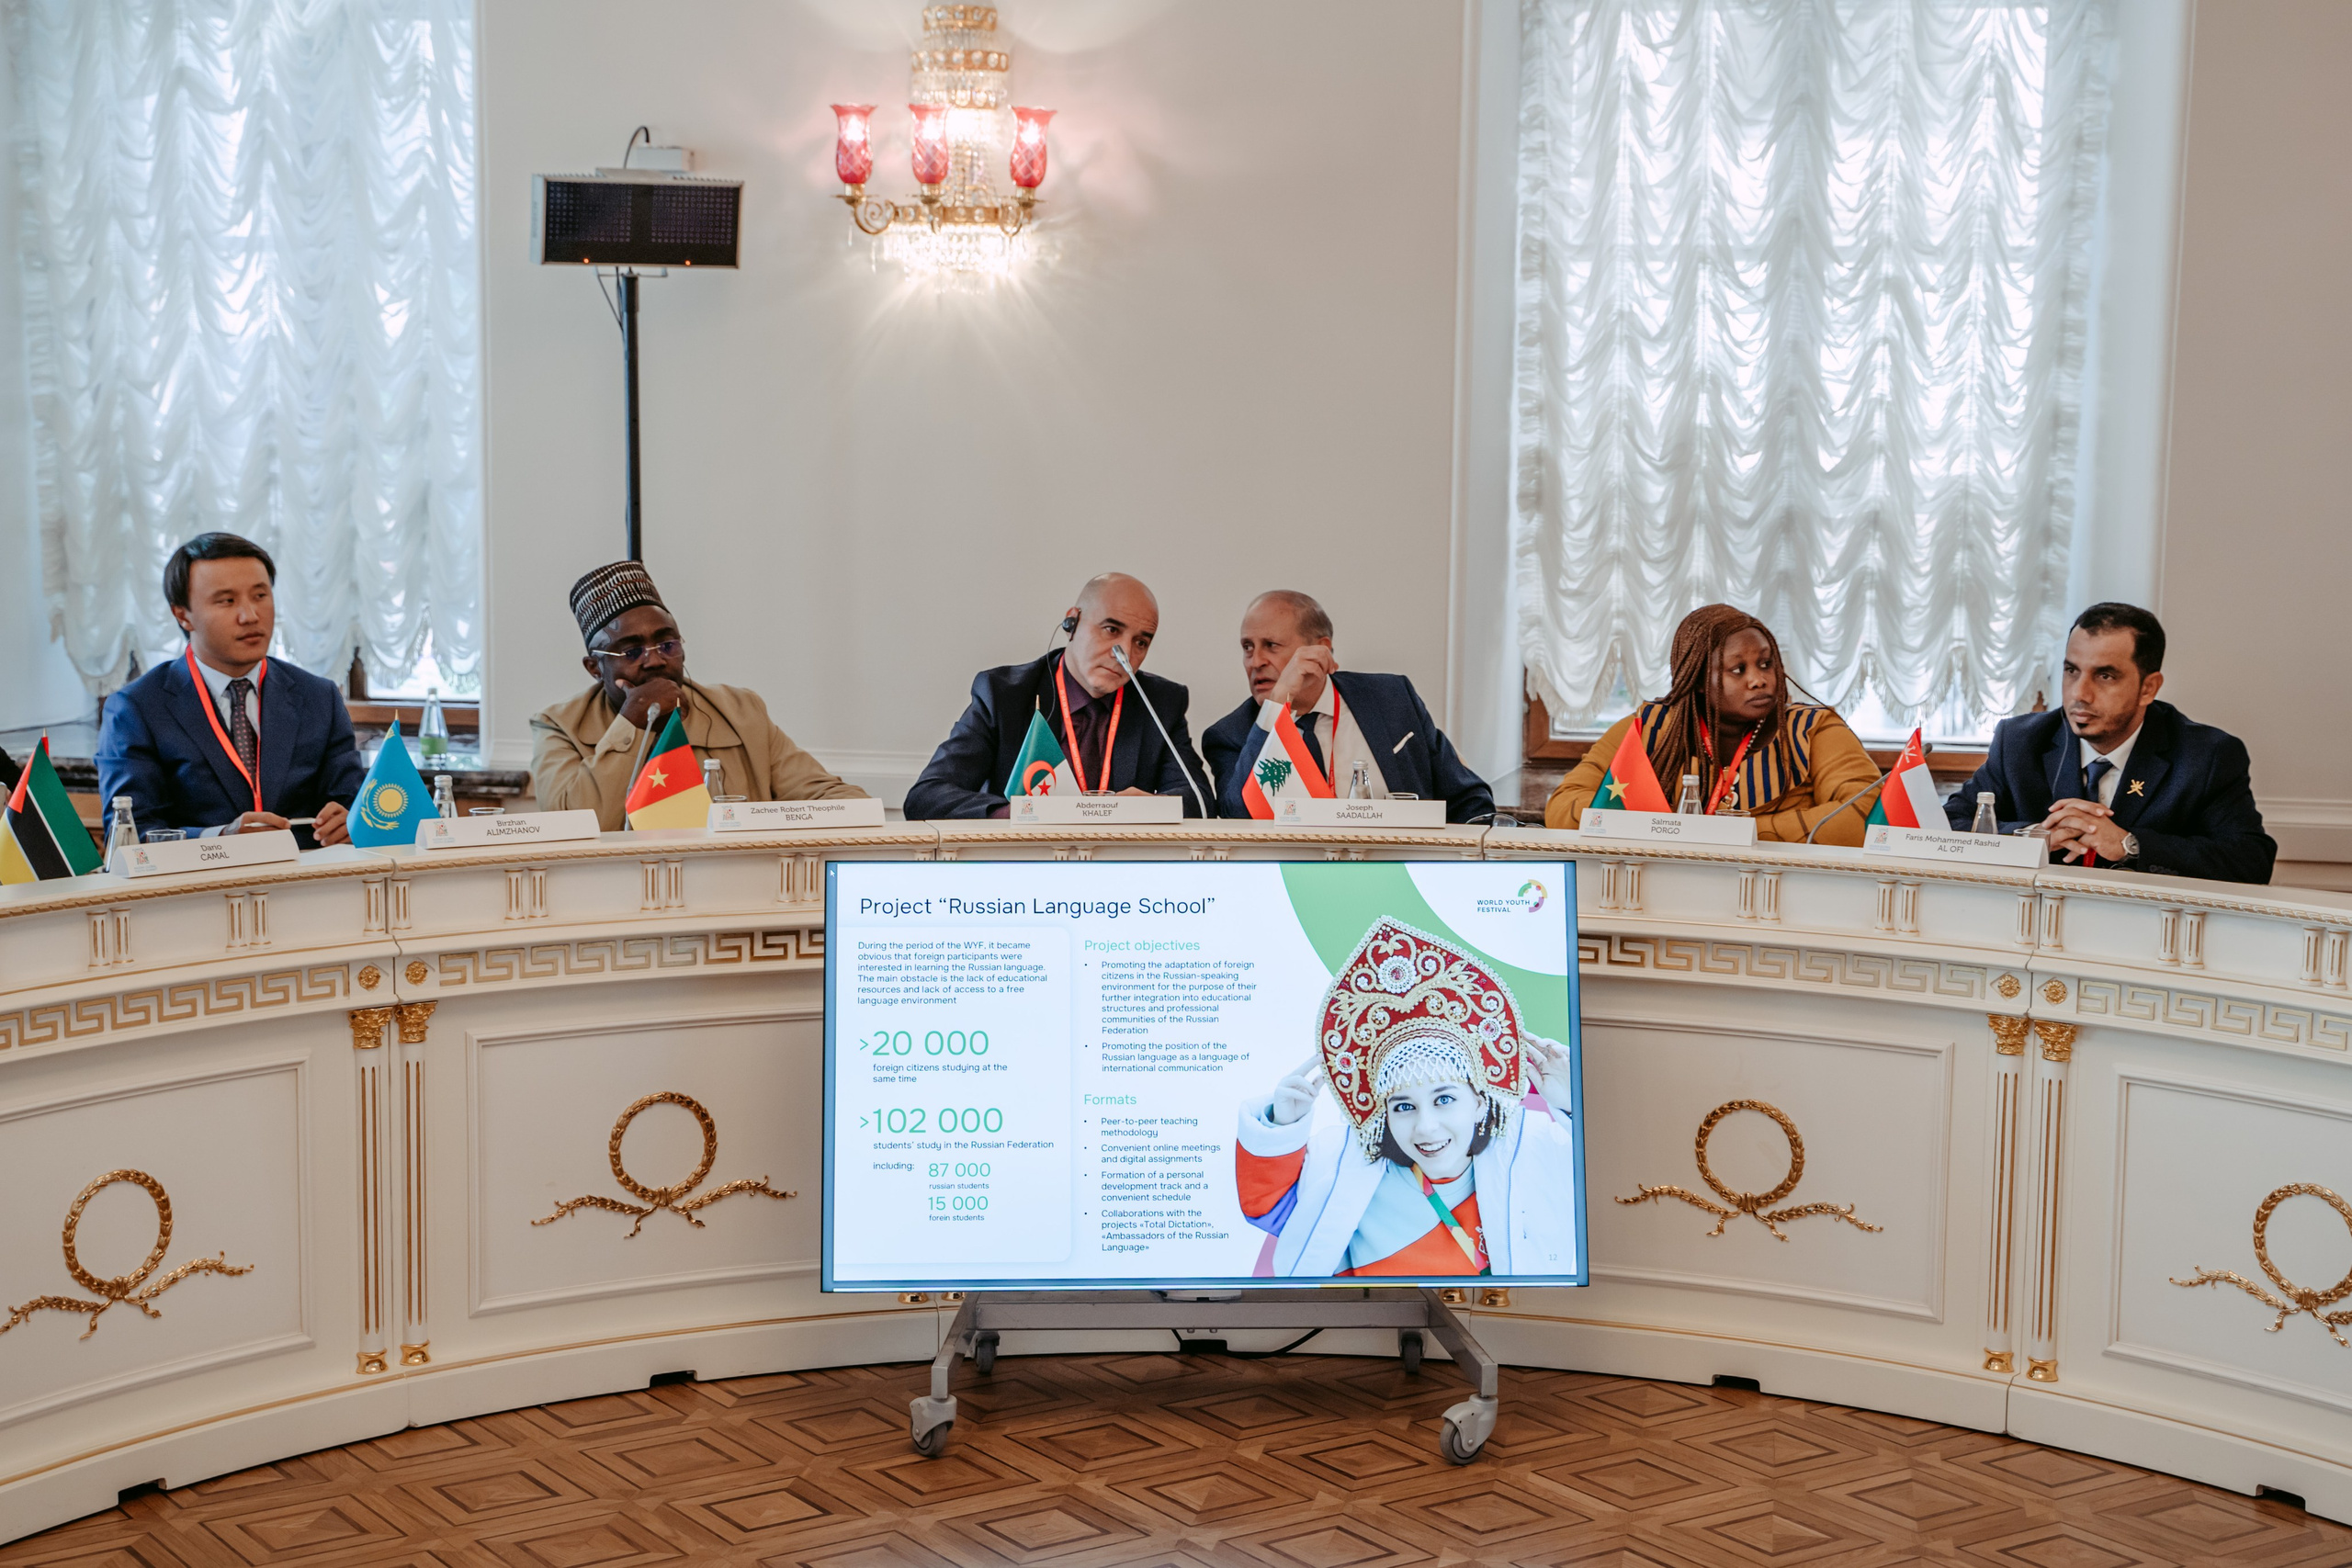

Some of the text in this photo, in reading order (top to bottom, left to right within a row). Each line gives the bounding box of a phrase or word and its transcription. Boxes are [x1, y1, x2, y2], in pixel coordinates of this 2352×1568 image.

[807, 805, 845, 813] Theophile
[1652, 818, 1681, 827] Salmata
[486, 826, 541, 836] ALIMZHANOV
[1651, 827, 1680, 835] PORGO
[1905, 833, 2000, 847] Faris Mohammed Rashid
[1950, 845, 1963, 853] OFI
[200, 852, 230, 861] CAMAL
[861, 898, 932, 918] Project
[1034, 898, 1131, 919] Language
[858, 942, 887, 951] During
[906, 942, 933, 951] period
[1085, 941, 1200, 953] Project objectives
[914, 953, 944, 962] foreign
[947, 953, 998, 962] participants
[915, 964, 949, 973] learning
[1003, 964, 1045, 973] language.
[1102, 961, 1146, 970] Promoting
[1165, 961, 1210, 970] adaptation
[1225, 961, 1254, 970] foreign
[987, 974, 995, 982] of
[1163, 972, 1238, 981] Russian-speaking
[858, 997, 899, 1006] language
[1134, 994, 1180, 1003] integration
[1167, 1004, 1218, 1013] professional
[924, 1031, 989, 1055] 000
[1137, 1054, 1177, 1063] language
[1199, 1054, 1238, 1063] language
[873, 1064, 904, 1073] foreign
[943, 1064, 979, 1073] studying
[1084, 1094, 1136, 1105] Formats
[939, 1108, 1002, 1134] 000
[1102, 1117, 1198, 1126] Peer-to-peer teaching
[1102, 1129, 1158, 1138] methodology
[917, 1142, 941, 1150] study
[1182, 1144, 1220, 1153] meetings
[1120, 1156, 1146, 1165] digital
[1148, 1155, 1203, 1165] assignments
[874, 1162, 914, 1171] including:
[929, 1163, 990, 1177] 87 000
[1148, 1170, 1156, 1179] of
[1167, 1171, 1204, 1179] personal
[1102, 1193, 1149, 1201] convenient
[928, 1196, 989, 1211] 15 000
[1102, 1221, 1137, 1229] projects
